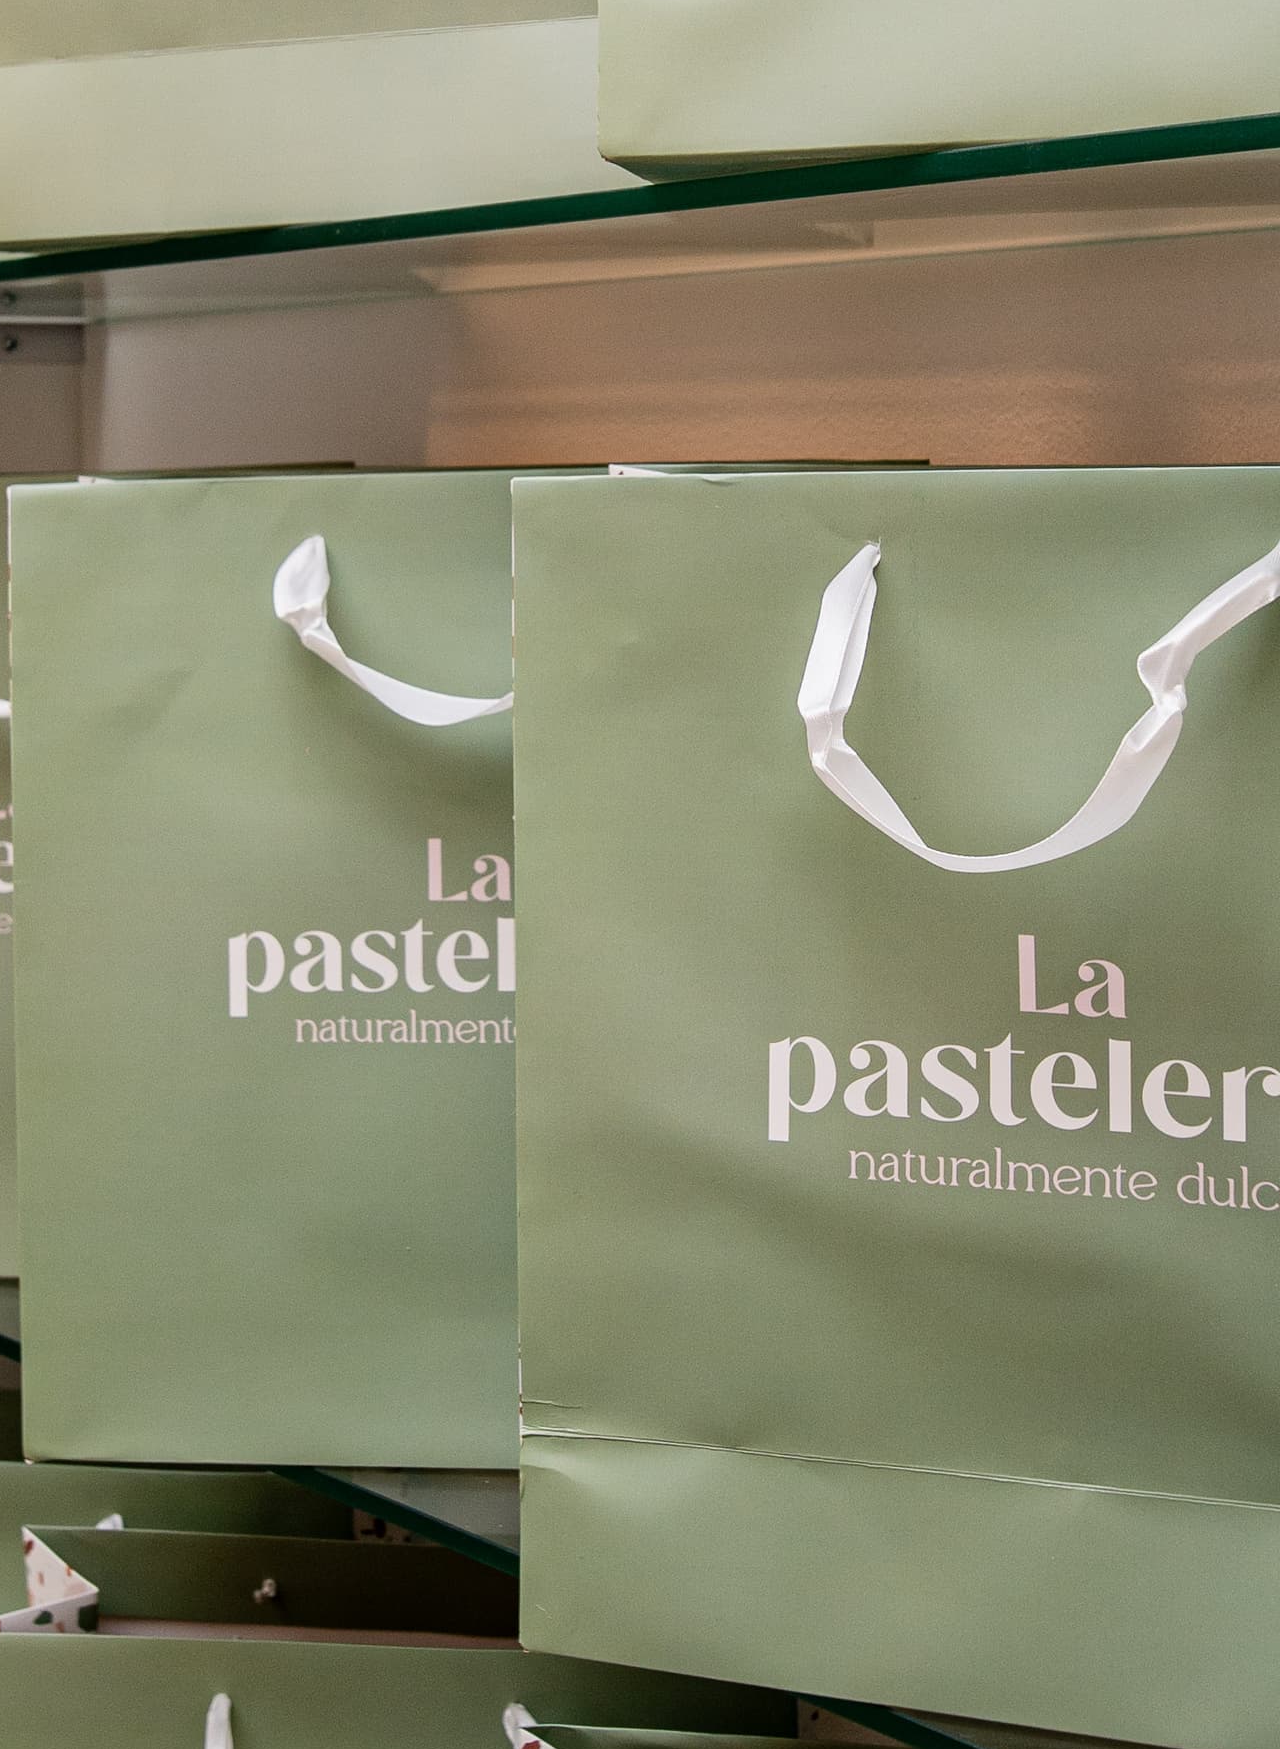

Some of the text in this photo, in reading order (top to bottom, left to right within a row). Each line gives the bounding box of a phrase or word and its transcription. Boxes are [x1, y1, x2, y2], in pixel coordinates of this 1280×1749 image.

[428, 838, 512, 901] La
[228, 917, 516, 1017] pastel
[1018, 934, 1127, 1018] La
[295, 1009, 516, 1043] naturalment
[848, 1147, 1158, 1200] naturalmente
